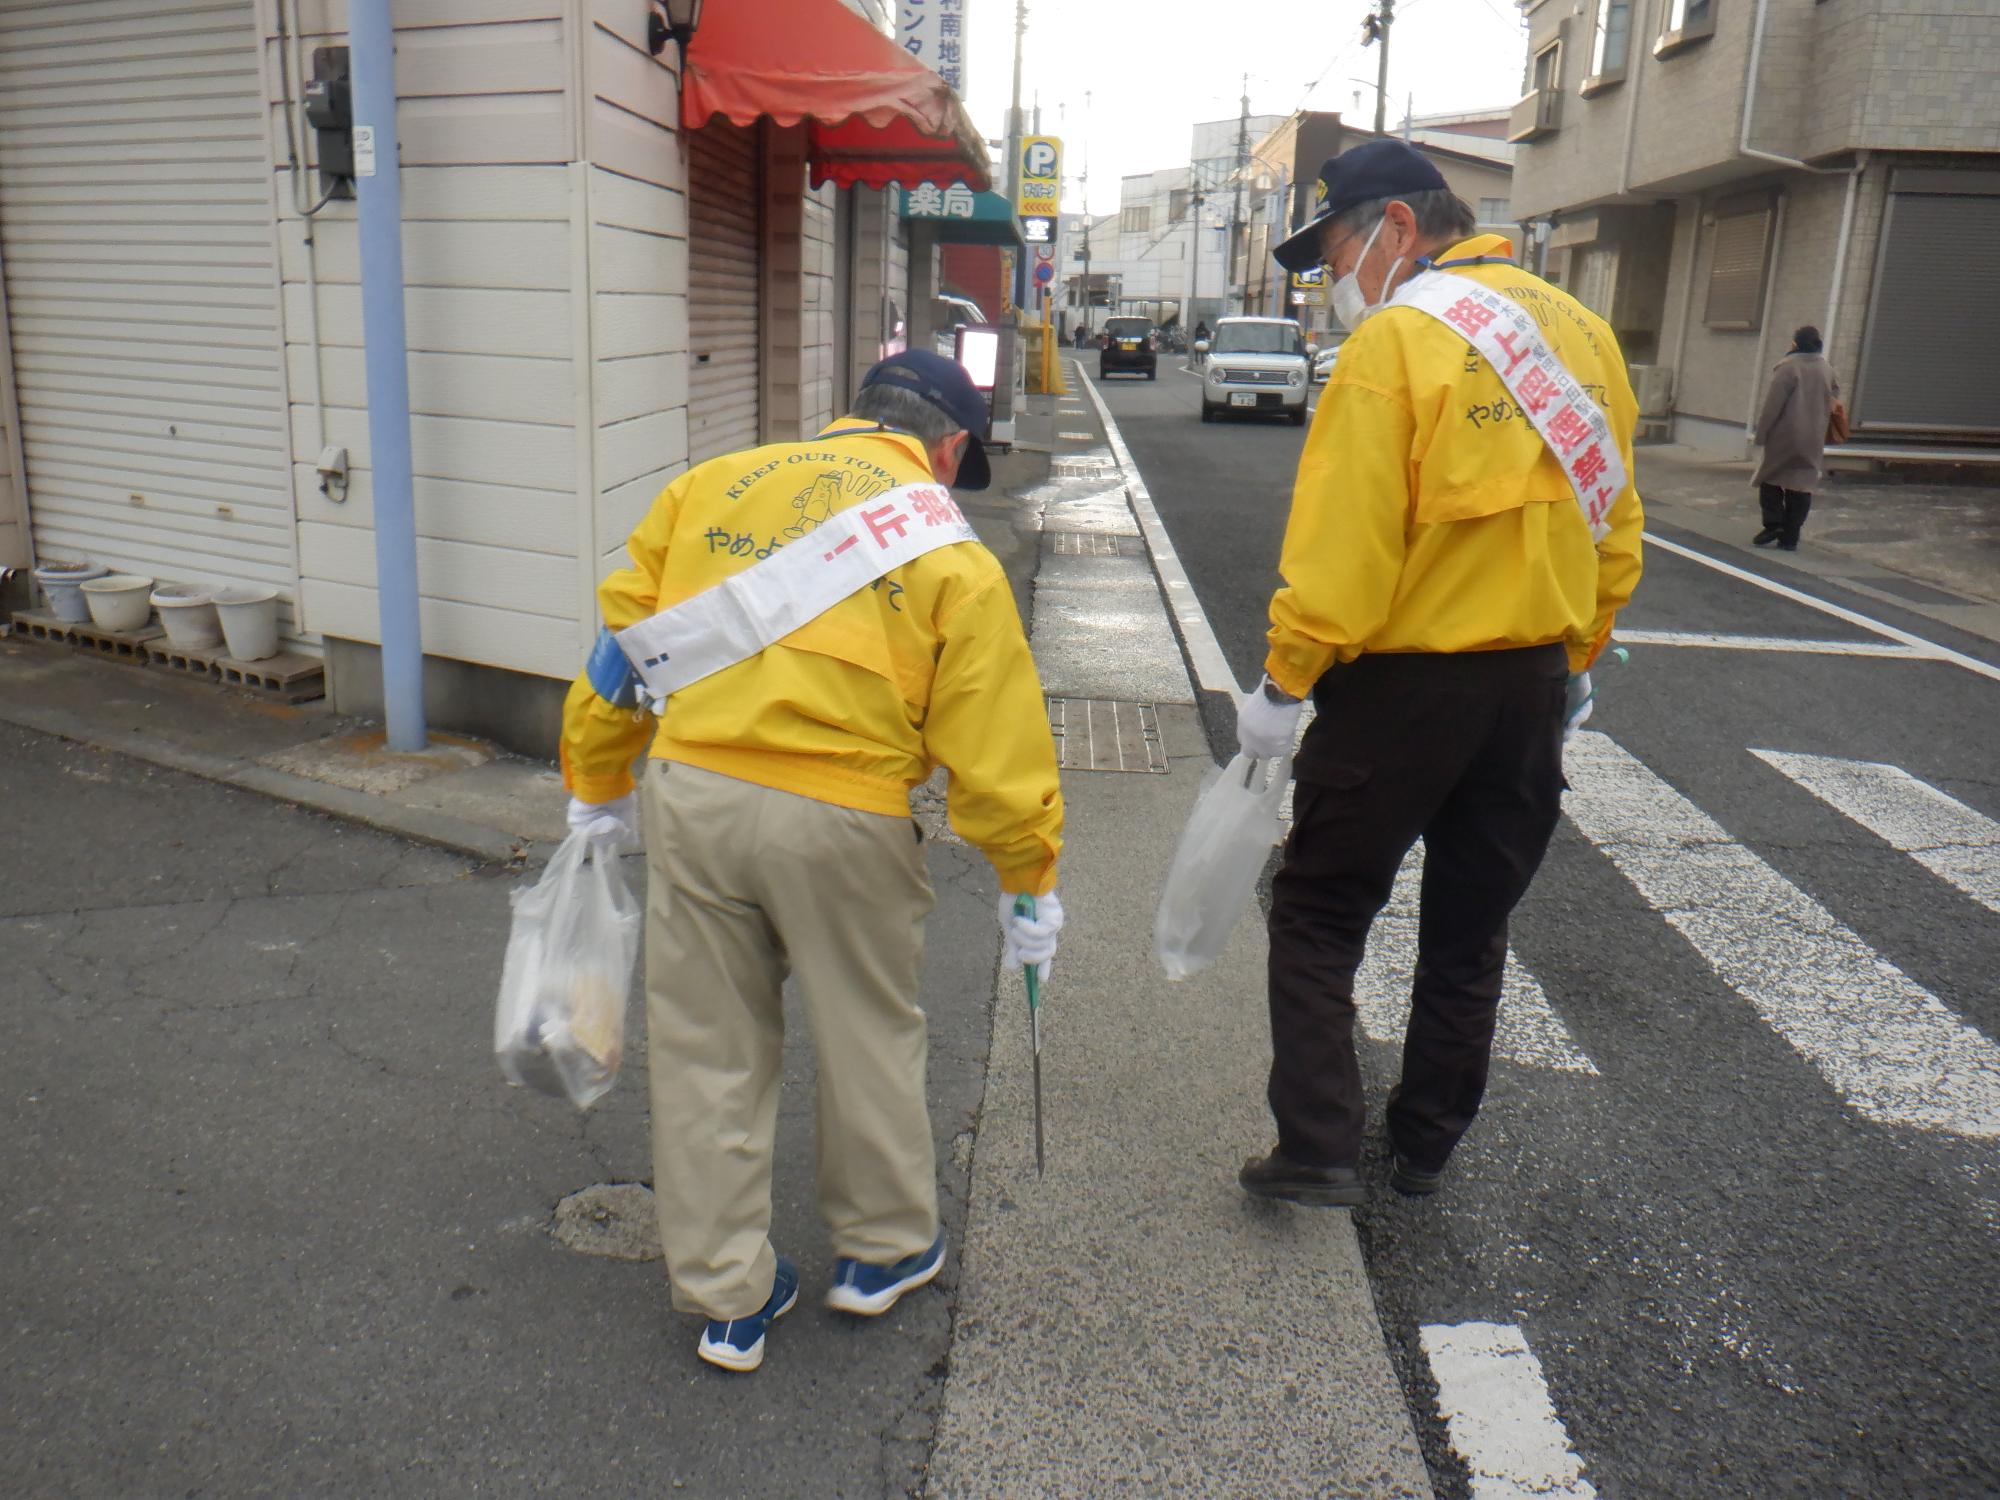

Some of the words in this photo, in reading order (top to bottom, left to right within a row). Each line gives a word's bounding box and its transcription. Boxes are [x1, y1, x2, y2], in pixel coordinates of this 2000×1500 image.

[903, 0, 925, 55] ンタ
[1030, 145, 1055, 174] P
[908, 182, 974, 218] 薬局
[1504, 286, 1552, 306] TOWN
[1556, 300, 1600, 357] CLEAN
[1442, 296, 1613, 527] 路上喫煙禁止
[726, 460, 781, 501] KEEP
[787, 453, 837, 465] OUR
[845, 456, 902, 489] TOWN
